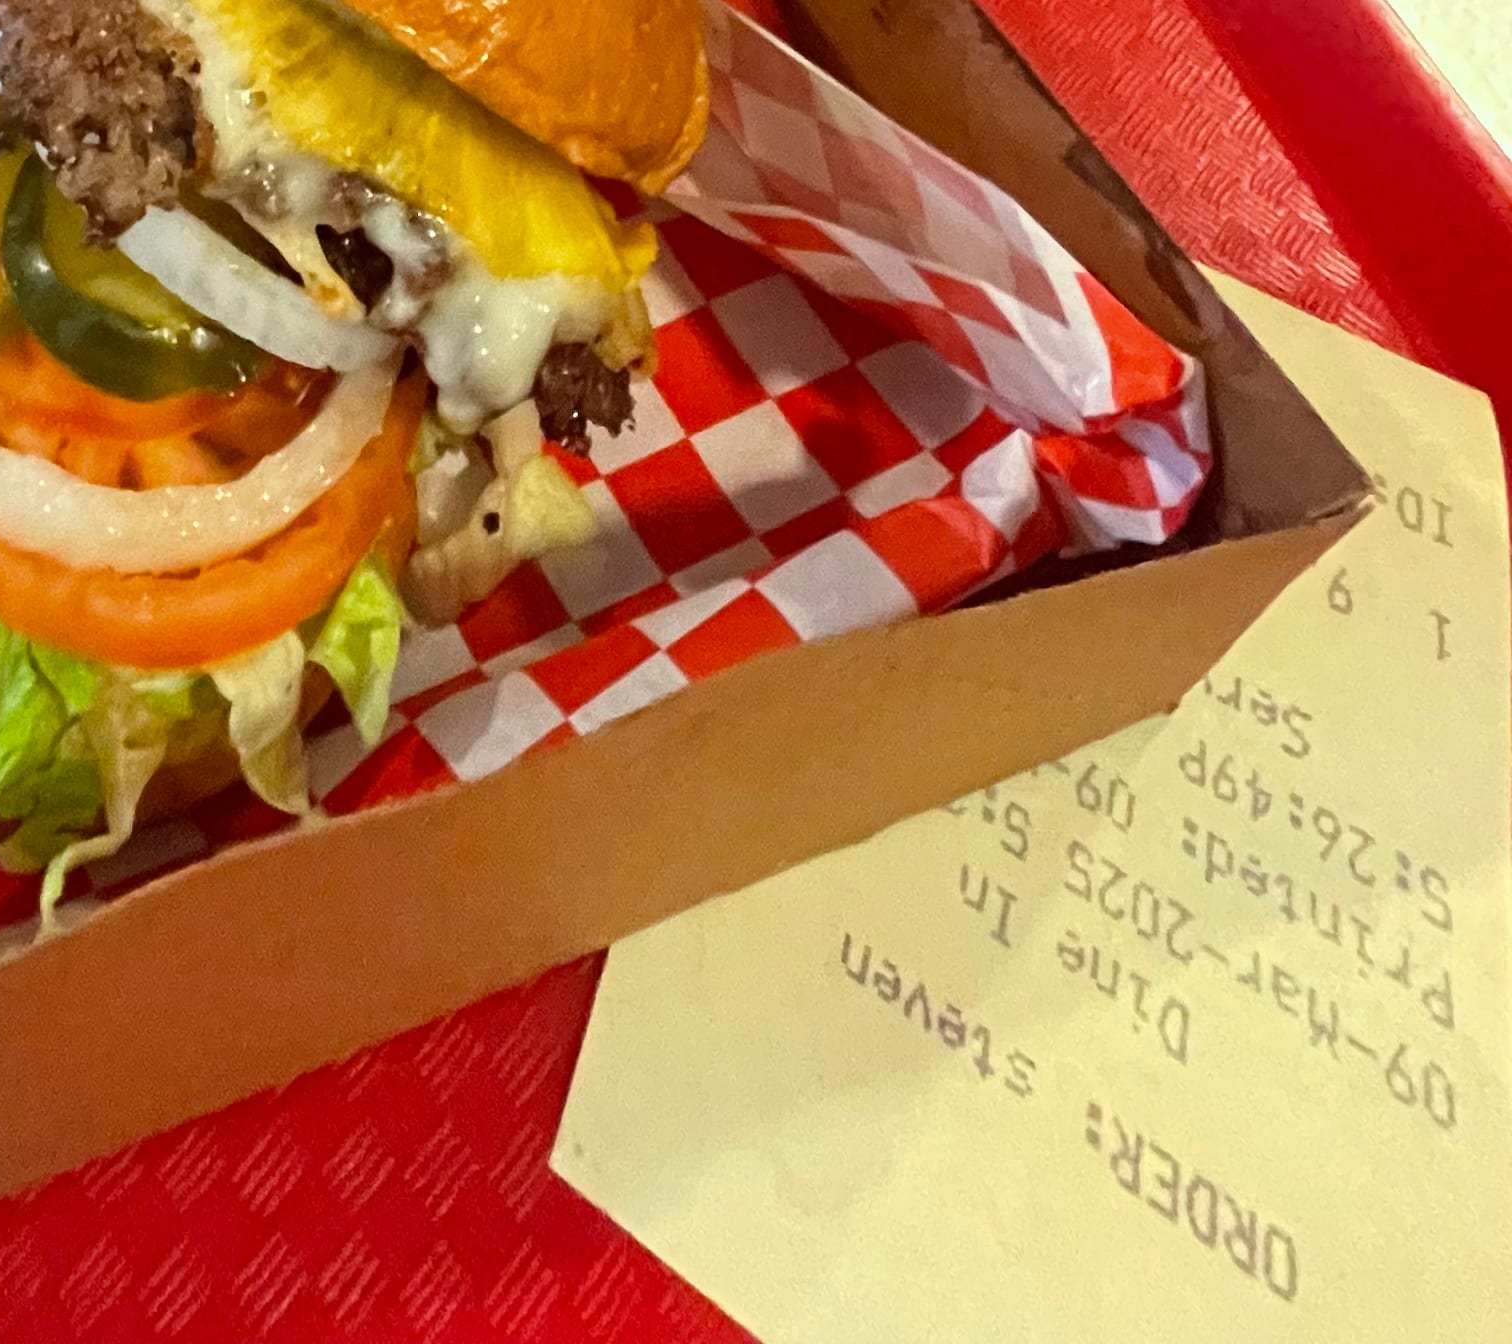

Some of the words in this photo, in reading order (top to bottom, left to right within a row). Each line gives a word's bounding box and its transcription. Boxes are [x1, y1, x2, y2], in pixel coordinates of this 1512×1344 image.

[943, 784, 1033, 862] 5:
[958, 864, 1020, 949] In
[1178, 740, 1455, 934] 5:26:49P
[1055, 929, 1191, 1065] Dine
[1063, 840, 1457, 1131] 09-Mar-2025
[1182, 816, 1456, 1031] Printed:
[841, 932, 1037, 1099] steven
[1086, 1102, 1300, 1303] ORDER:
